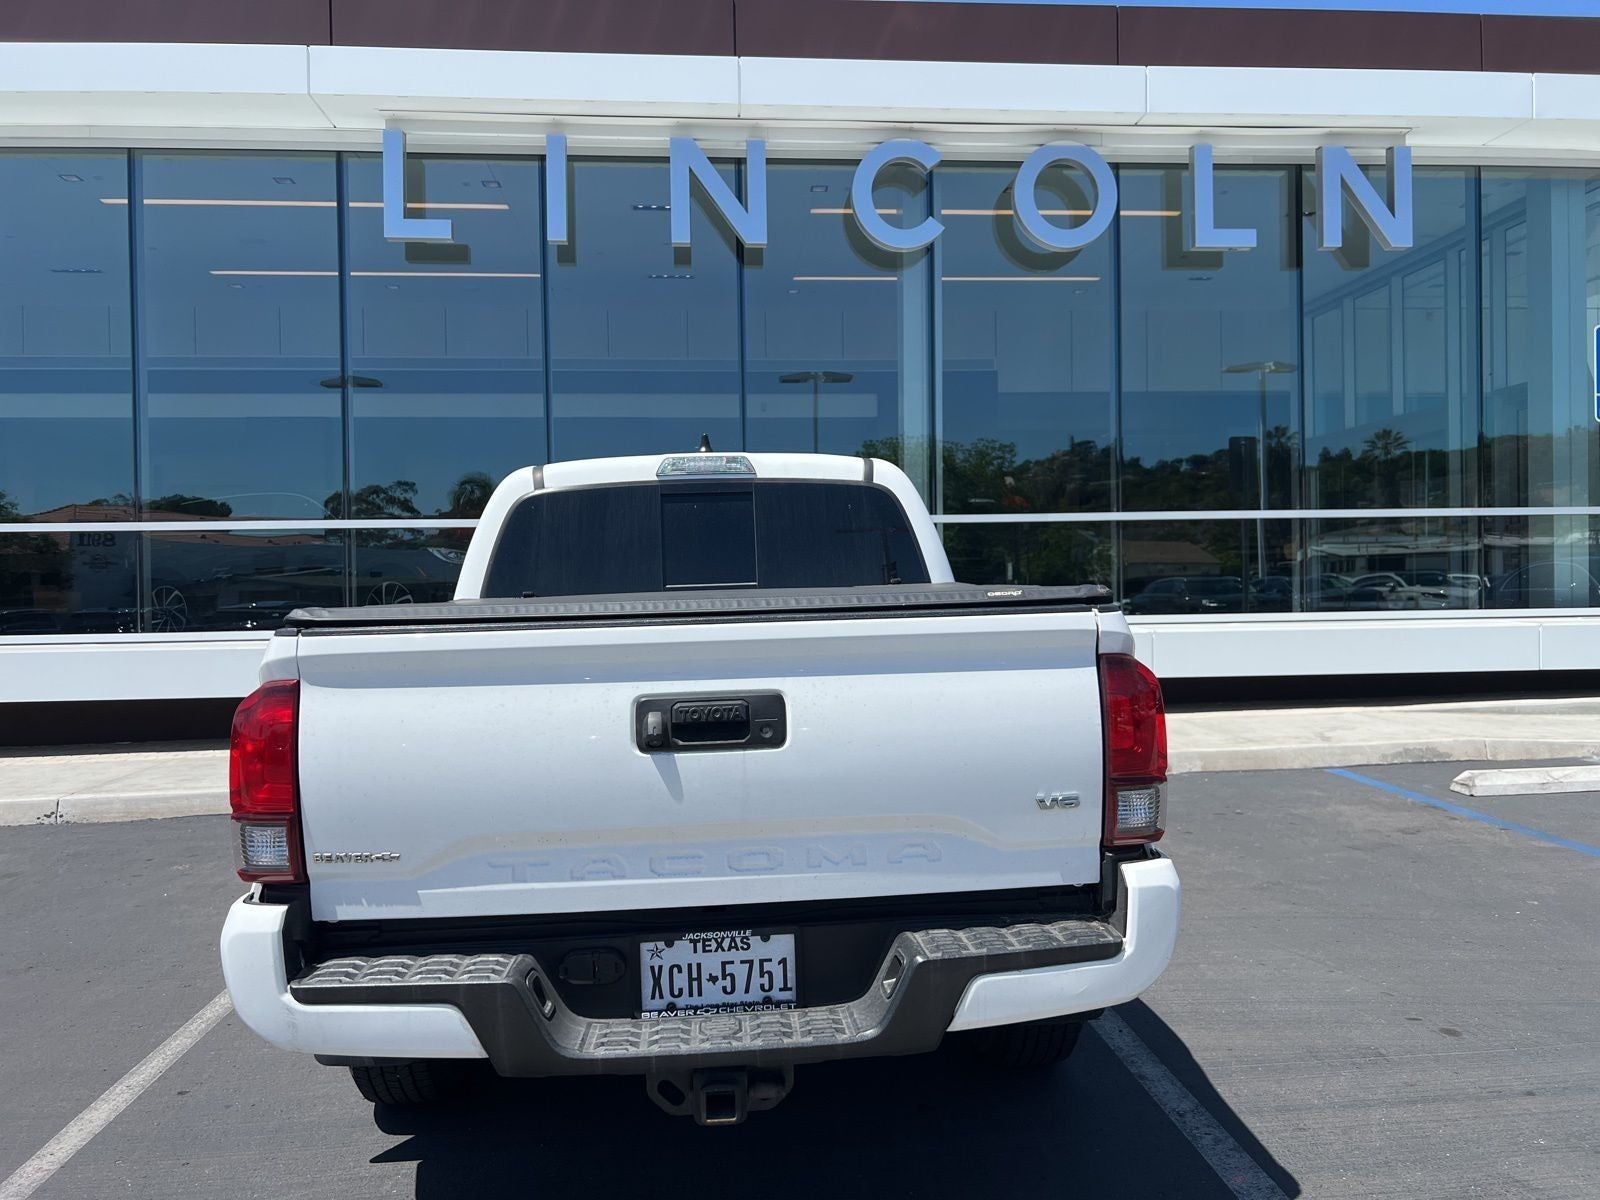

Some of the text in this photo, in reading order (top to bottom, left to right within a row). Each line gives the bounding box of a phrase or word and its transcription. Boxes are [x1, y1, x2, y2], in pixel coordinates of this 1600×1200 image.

[382, 128, 1415, 253] LINCOLN
[678, 705, 746, 722] TOYOTA
[1035, 791, 1081, 810] V6
[313, 852, 374, 864] BEAVER
[488, 838, 943, 884] TACOMA
[682, 929, 752, 941] JACKSONVILLE
[689, 936, 751, 954] TEXAS
[649, 957, 793, 1001] XCH 5751
[641, 1003, 797, 1020] BEAVER CHEVROLET
